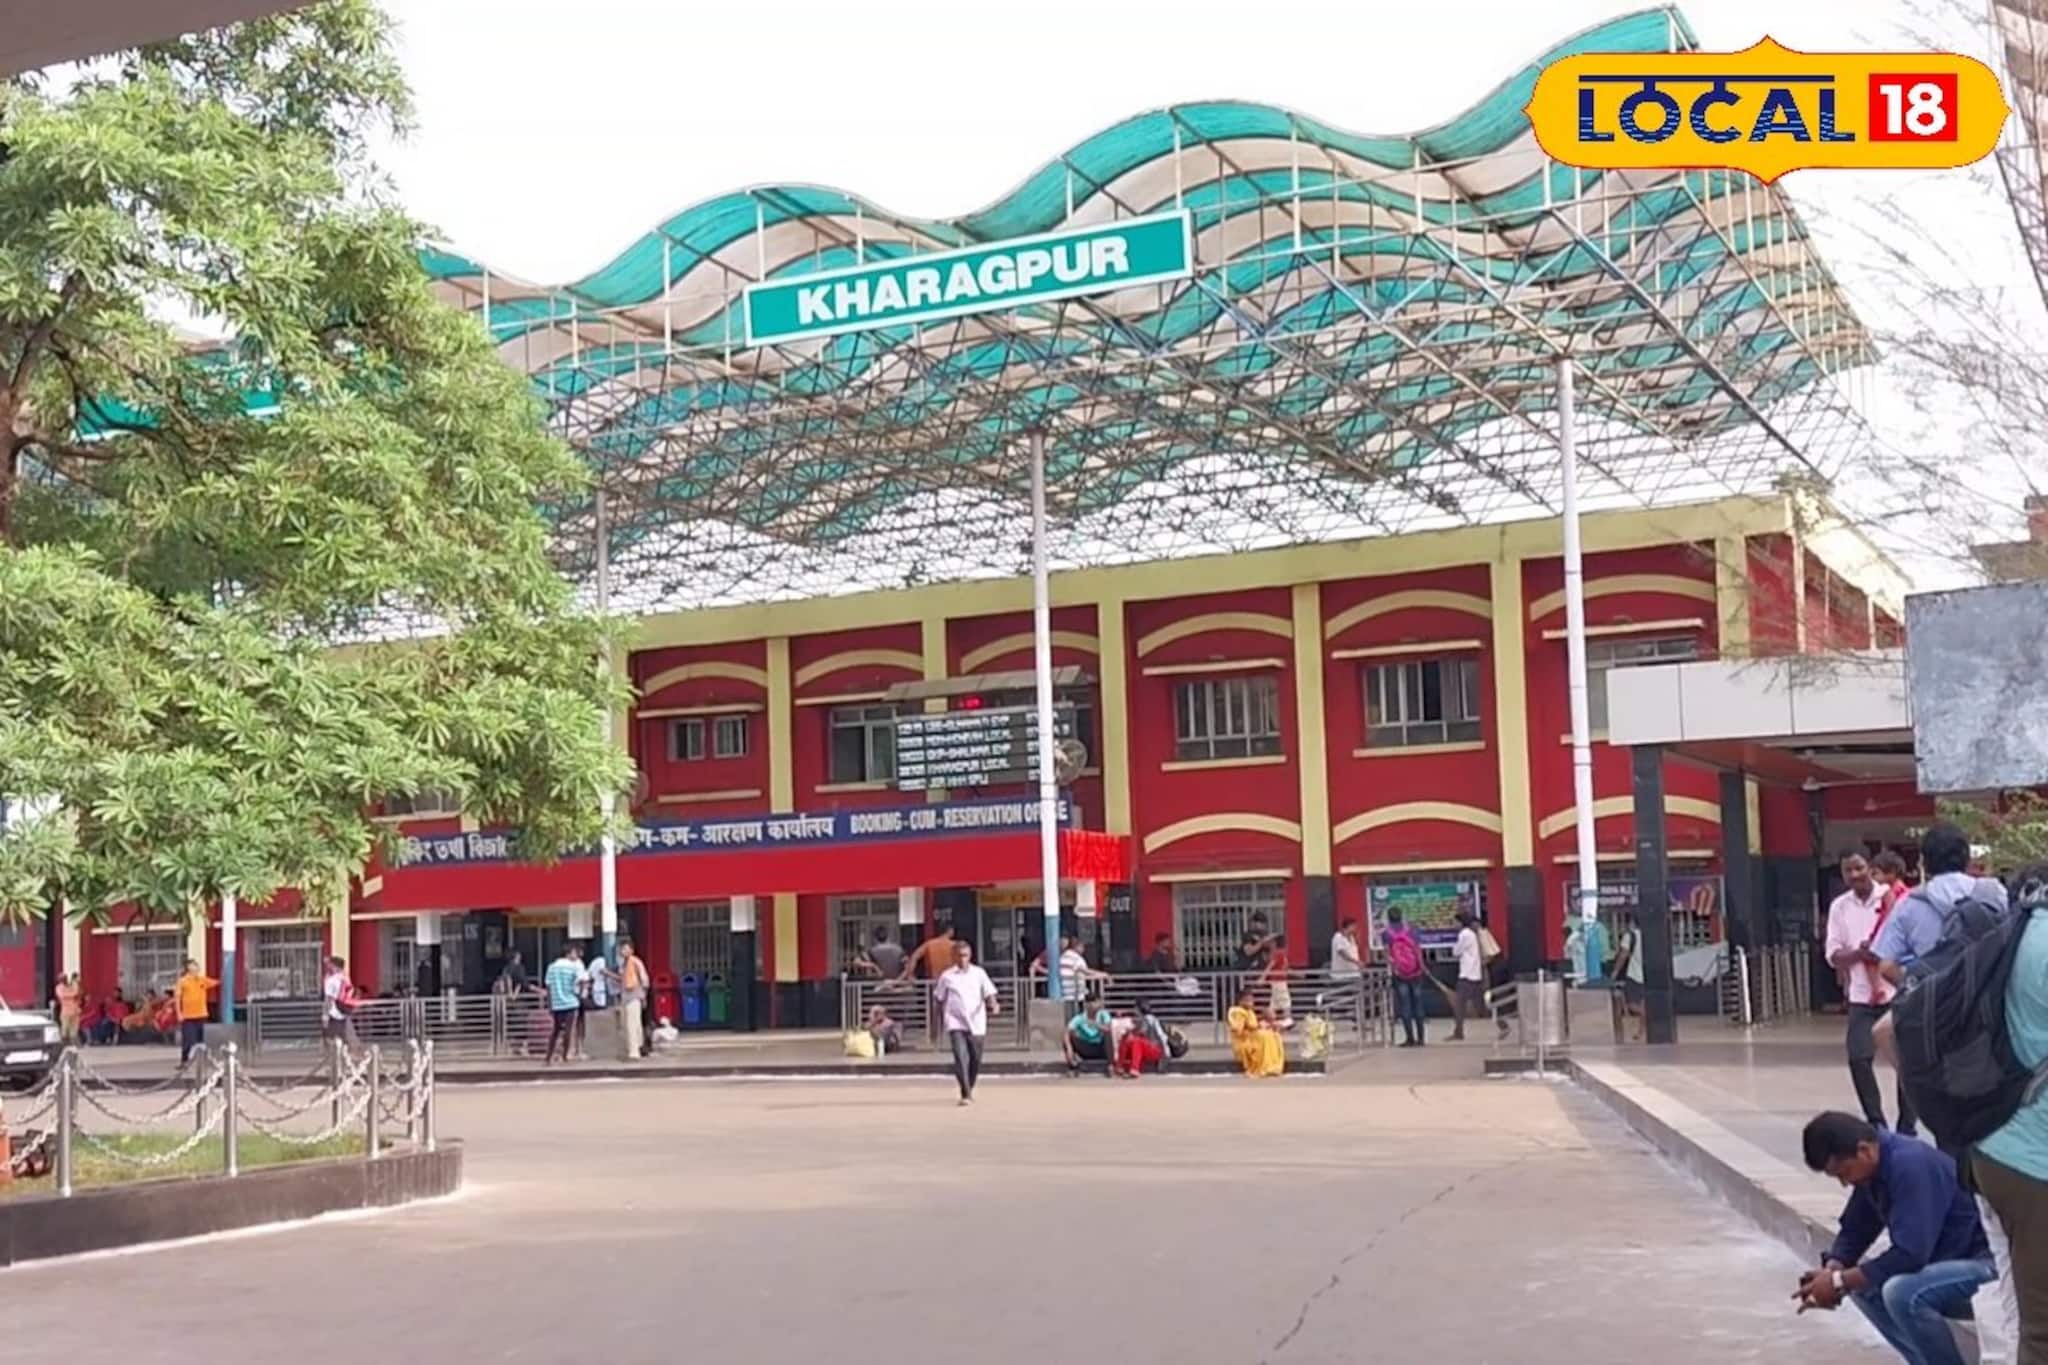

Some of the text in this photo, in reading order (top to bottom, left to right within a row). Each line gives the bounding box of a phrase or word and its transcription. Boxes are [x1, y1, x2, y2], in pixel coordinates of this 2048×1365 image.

[799, 236, 1130, 324] KHARAGPUR
[1023, 800, 1068, 823] OFE
[702, 821, 763, 845] आरक्षण
[766, 813, 835, 840] कार्यालय
[1110, 896, 1131, 913] OUT
